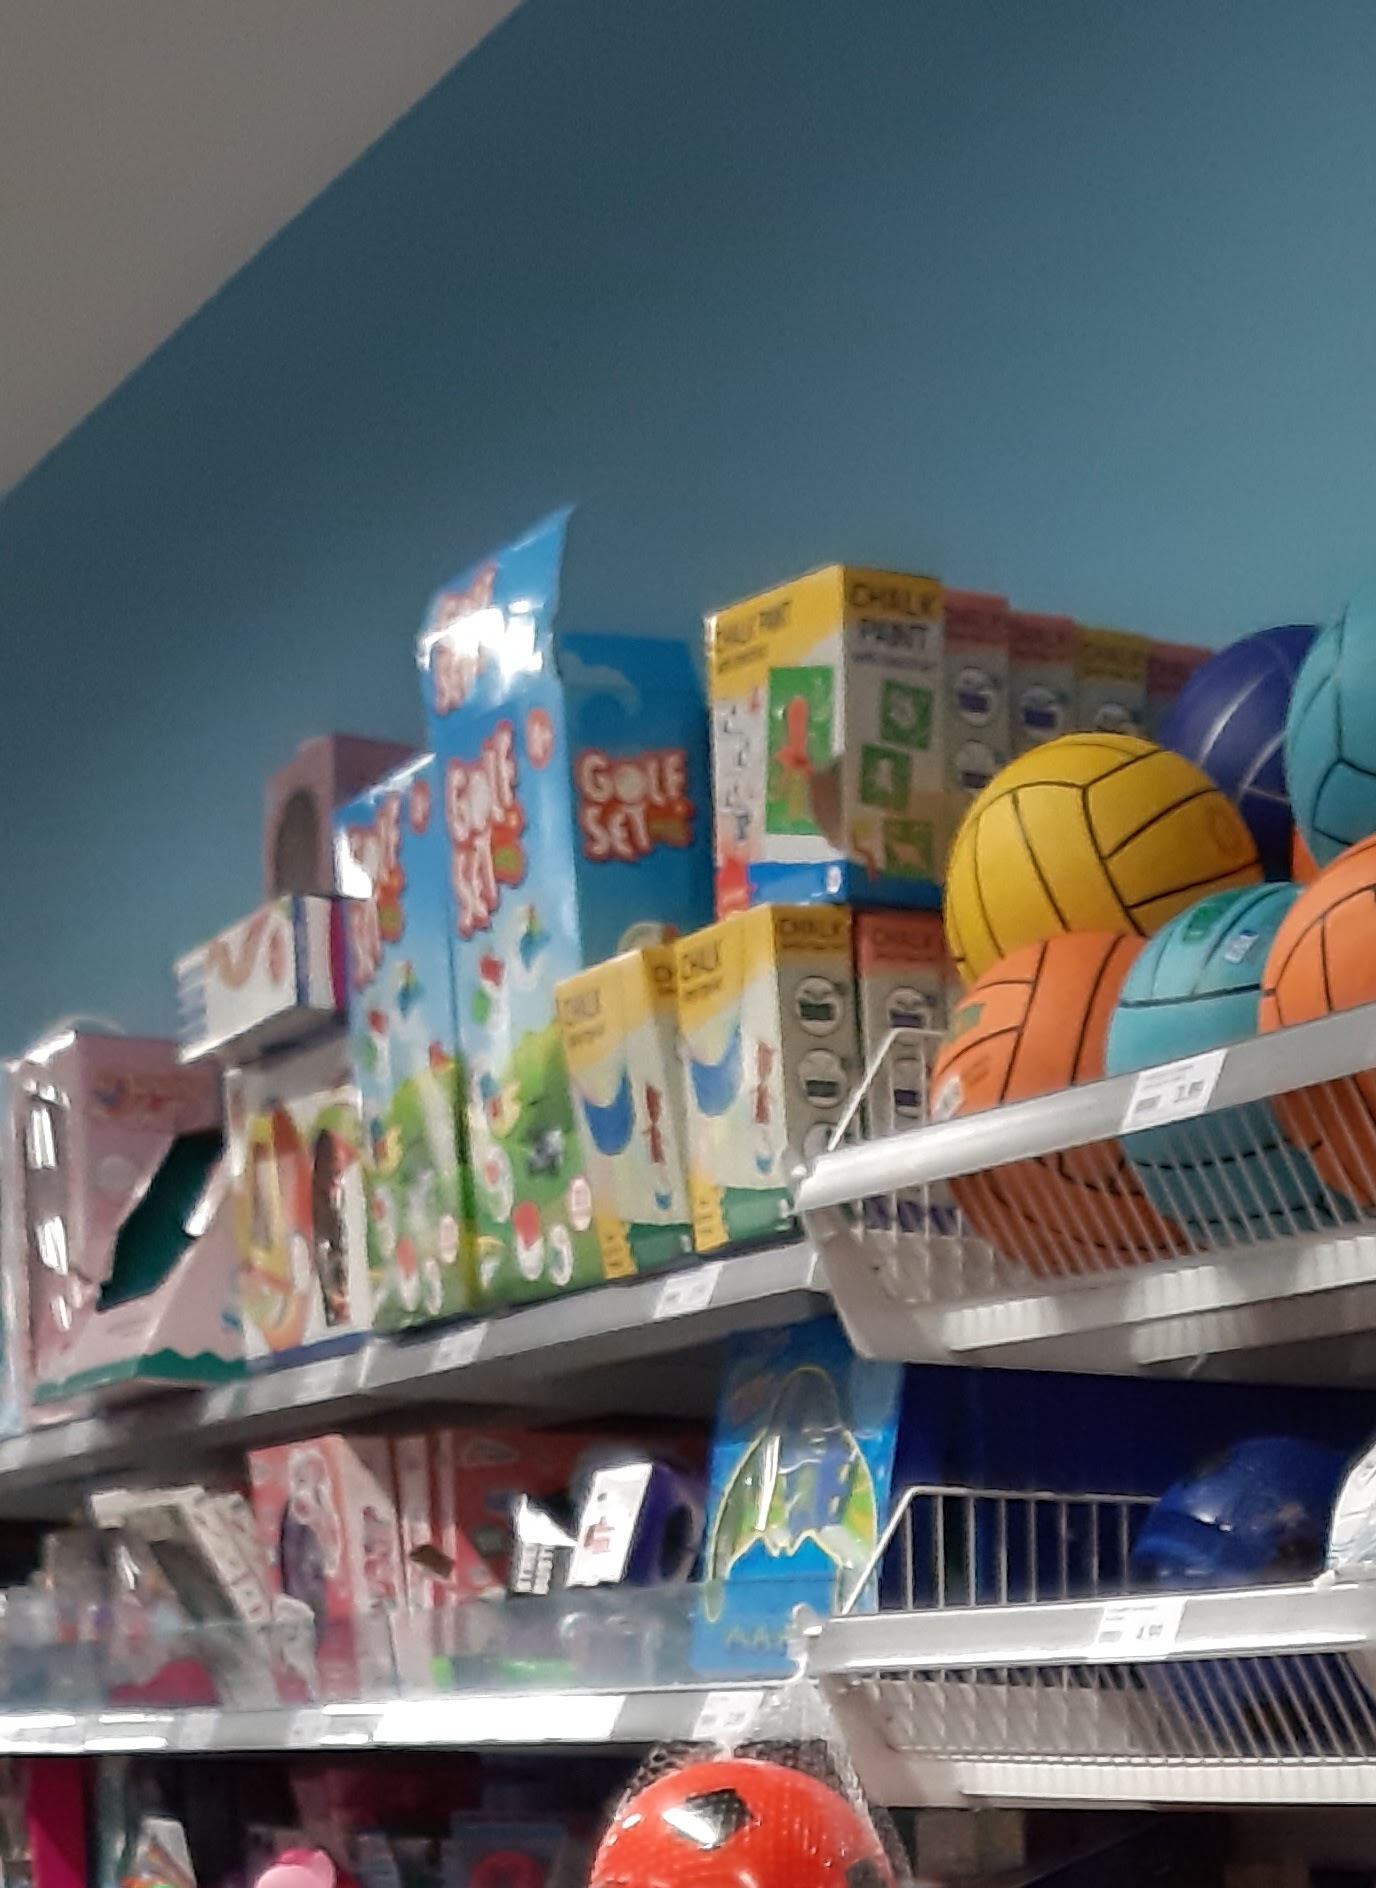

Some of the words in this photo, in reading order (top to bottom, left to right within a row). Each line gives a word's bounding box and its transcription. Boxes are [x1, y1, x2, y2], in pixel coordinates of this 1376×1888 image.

[446, 720, 517, 844] GOLF
[576, 749, 688, 808] GOLF
[579, 802, 655, 864] SET
